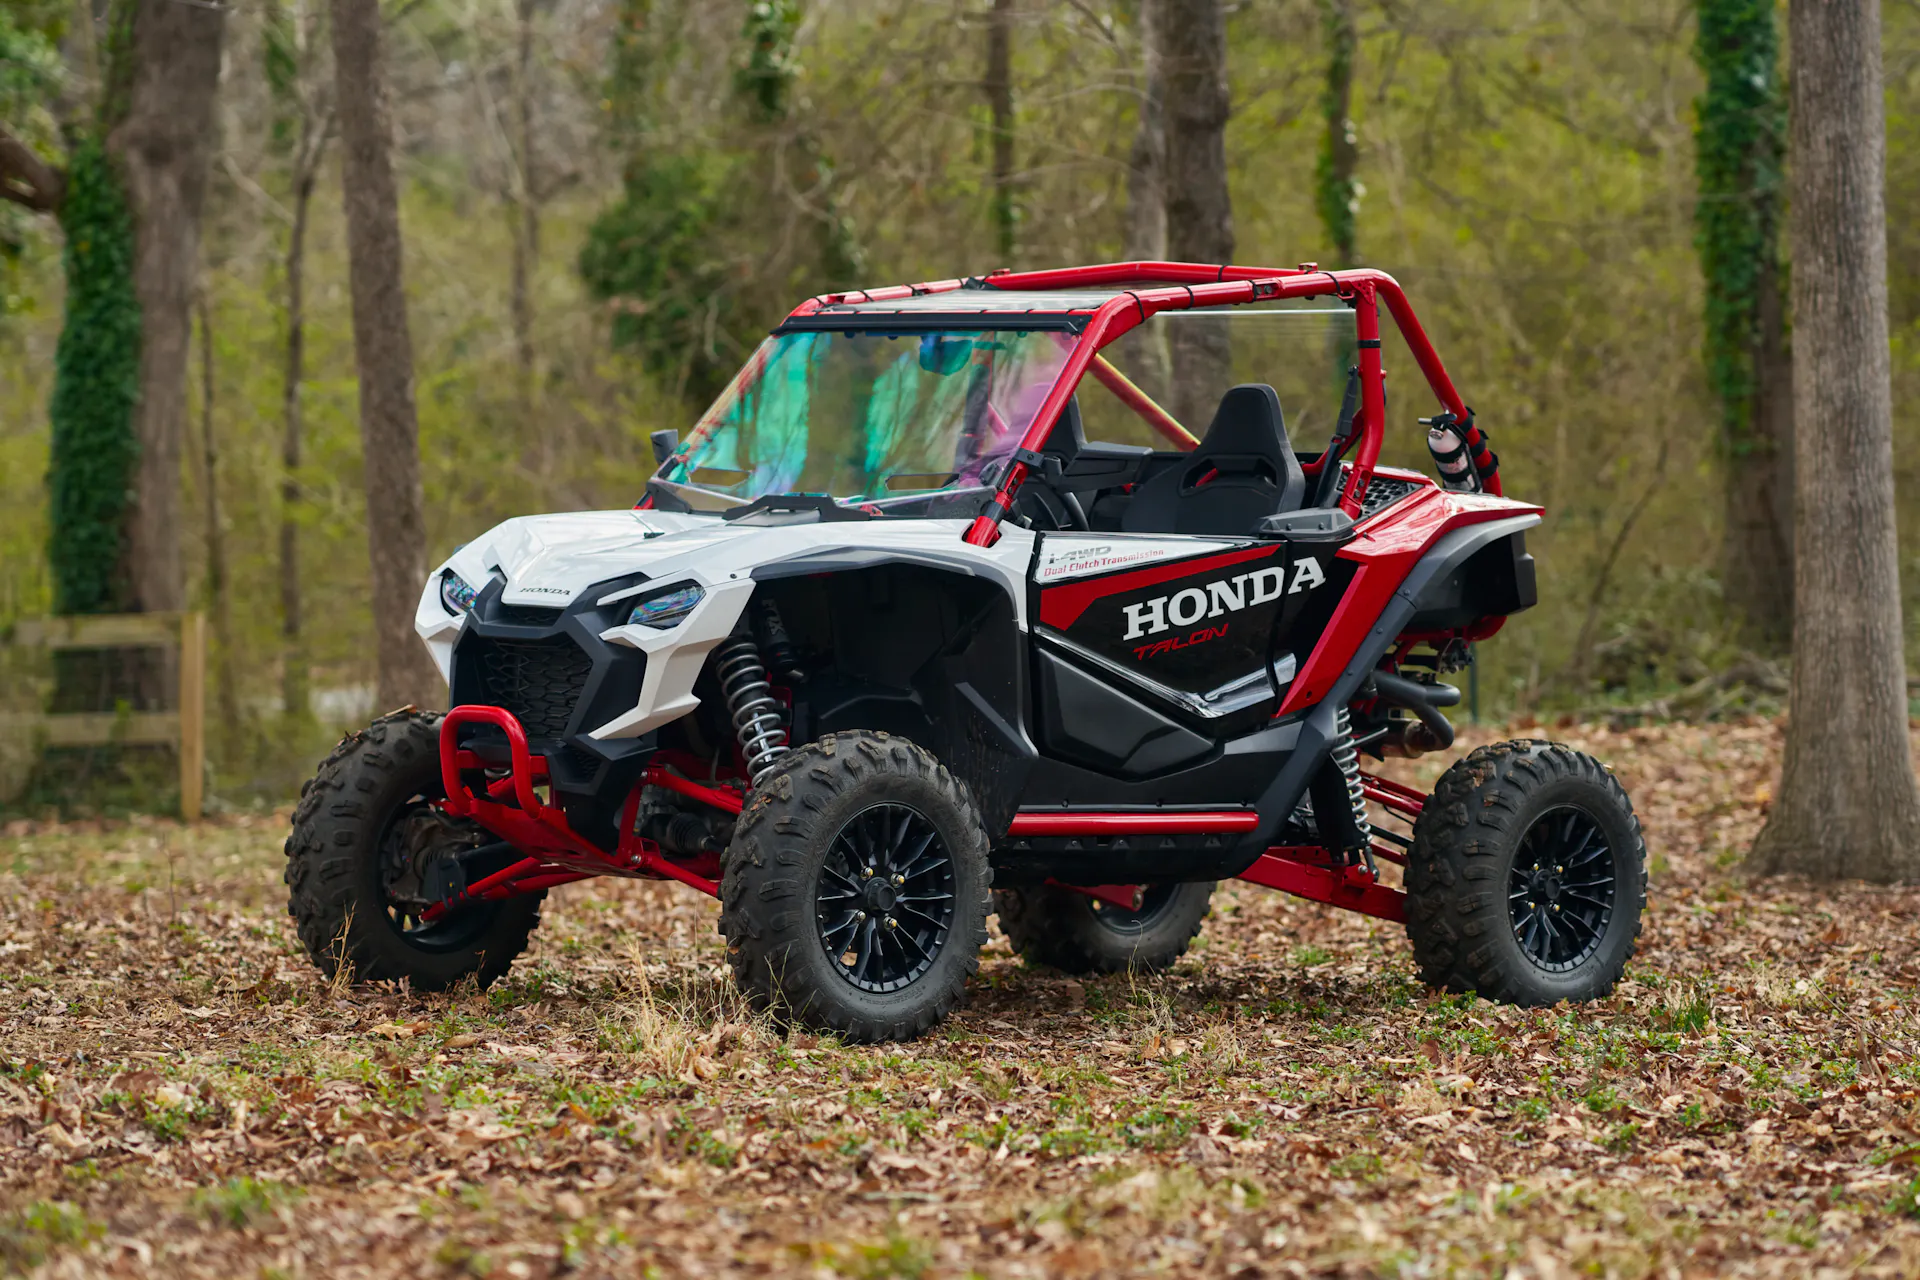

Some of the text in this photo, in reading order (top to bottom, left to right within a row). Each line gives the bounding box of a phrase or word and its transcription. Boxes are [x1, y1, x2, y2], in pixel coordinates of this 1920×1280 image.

[1044, 549, 1164, 577] Dual Clutch Transmission
[1048, 546, 1112, 565] i-4WD
[518, 587, 571, 596] HONDA
[1123, 556, 1327, 641] HONDA
[1133, 623, 1229, 660] TALON
